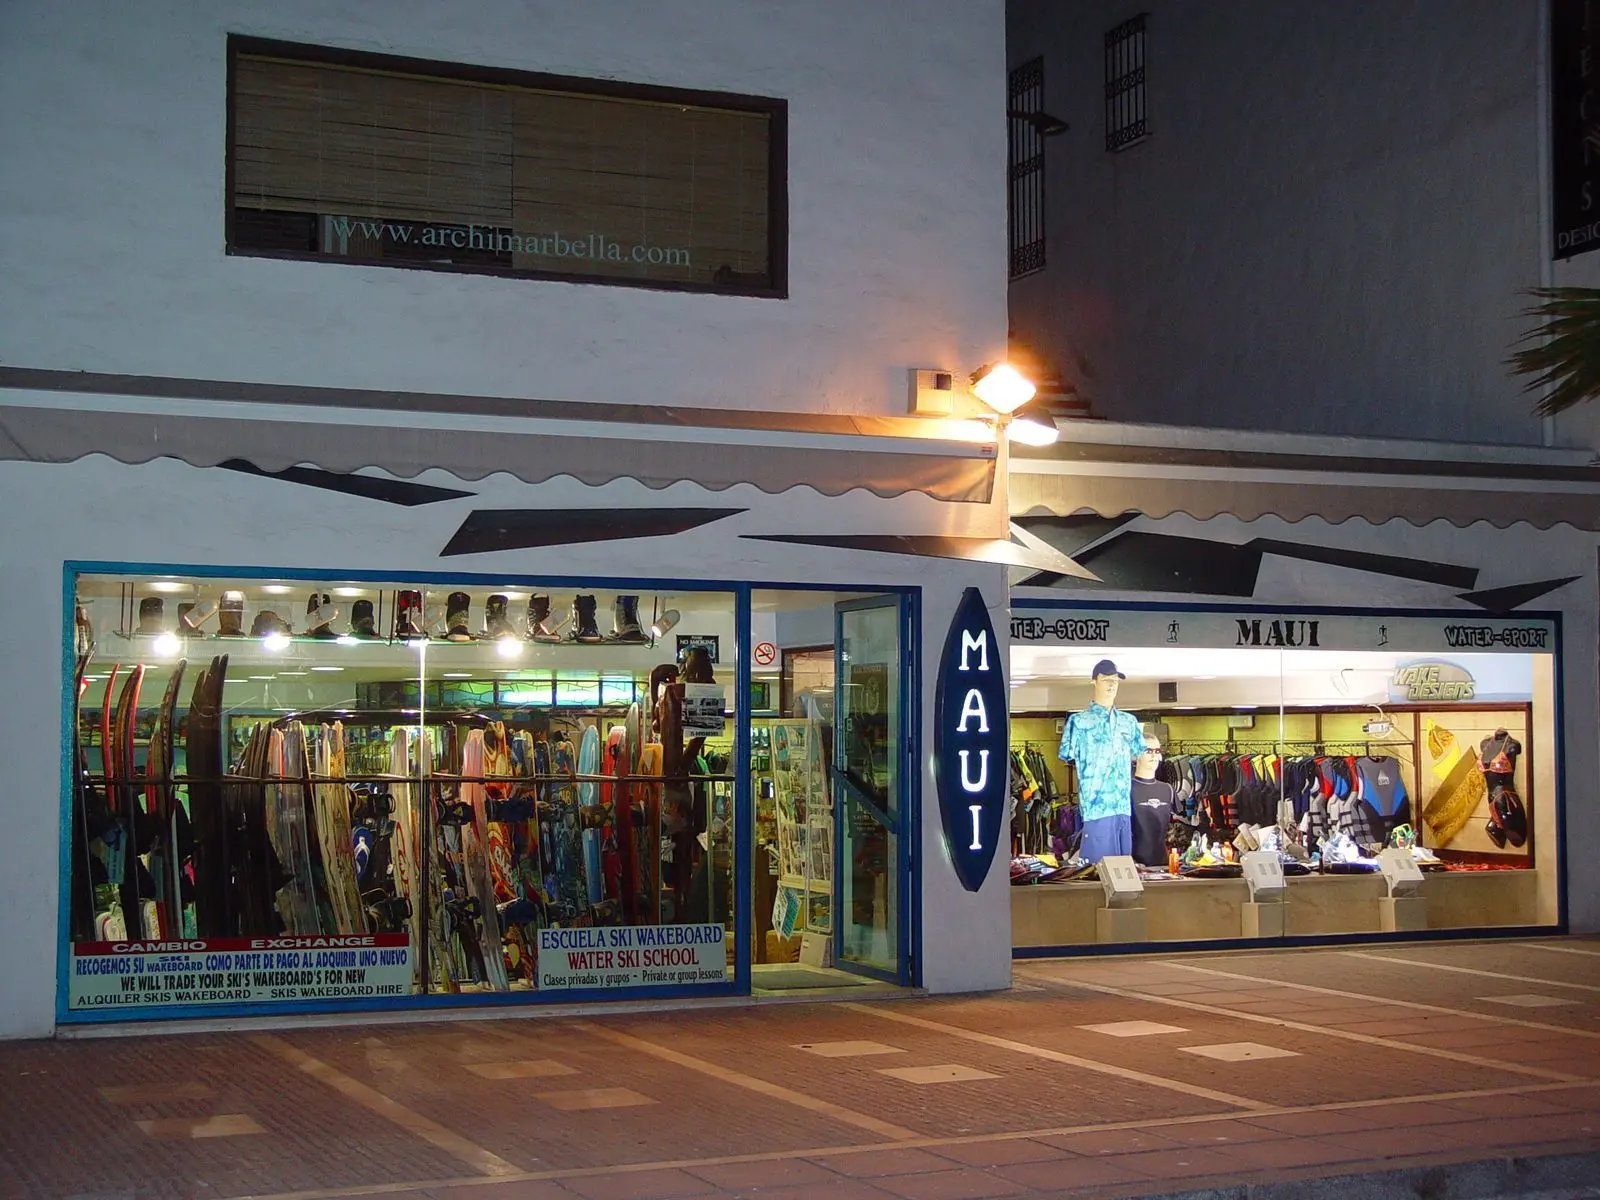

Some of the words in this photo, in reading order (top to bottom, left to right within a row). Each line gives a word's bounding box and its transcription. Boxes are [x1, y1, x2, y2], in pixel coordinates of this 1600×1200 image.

[1235, 619, 1320, 647] MAUI
[1444, 625, 1548, 648] WATER-SPORT
[1394, 665, 1440, 685] WAKE
[957, 629, 989, 850] MAUI
[112, 941, 208, 953] CAMBIO
[251, 936, 376, 949] EXCHANGE
[542, 928, 606, 950] ESCUELA
[610, 926, 632, 947] SKI
[636, 926, 722, 946] WAKEBOARD
[76, 957, 131, 976] RECOGEMOS
[133, 956, 145, 974] SU
[146, 961, 203, 973] WAKEBOARD
[205, 955, 232, 972] COMO
[234, 953, 261, 970] PARTE
[263, 952, 274, 969] DE
[276, 952, 300, 969] PAGO
[302, 952, 314, 968] AL
[315, 951, 357, 968] ADQUIRIR
[359, 951, 378, 967] UNO
[379, 950, 408, 966] NUEVO
[567, 950, 613, 970] WATER
[617, 950, 640, 969] SKI
[643, 948, 699, 967] SCHOOL
[121, 976, 136, 992] WE
[138, 976, 161, 991] WILL
[163, 974, 196, 991] TRADE
[198, 973, 225, 989] YOUR
[226, 972, 250, 988] SKI'S
[253, 970, 322, 987] WAKEBOARD'S
[324, 969, 342, 985] FOR
[345, 969, 366, 984] NEW
[543, 973, 567, 986] Clases
[568, 972, 598, 987] privadas
[599, 976, 604, 989] y
[605, 974, 630, 988] grupos
[642, 969, 668, 982] Private
[669, 971, 676, 981] or
[677, 970, 698, 984] group
[698, 967, 723, 981] lessons
[77, 993, 141, 1006] ALQUILER
[144, 991, 171, 1003] SKIS
[174, 989, 251, 1002] WAKEBOARD
[271, 988, 297, 998] SKIS
[300, 985, 373, 997] WAKEBOARD
[376, 984, 403, 994] HIRE
